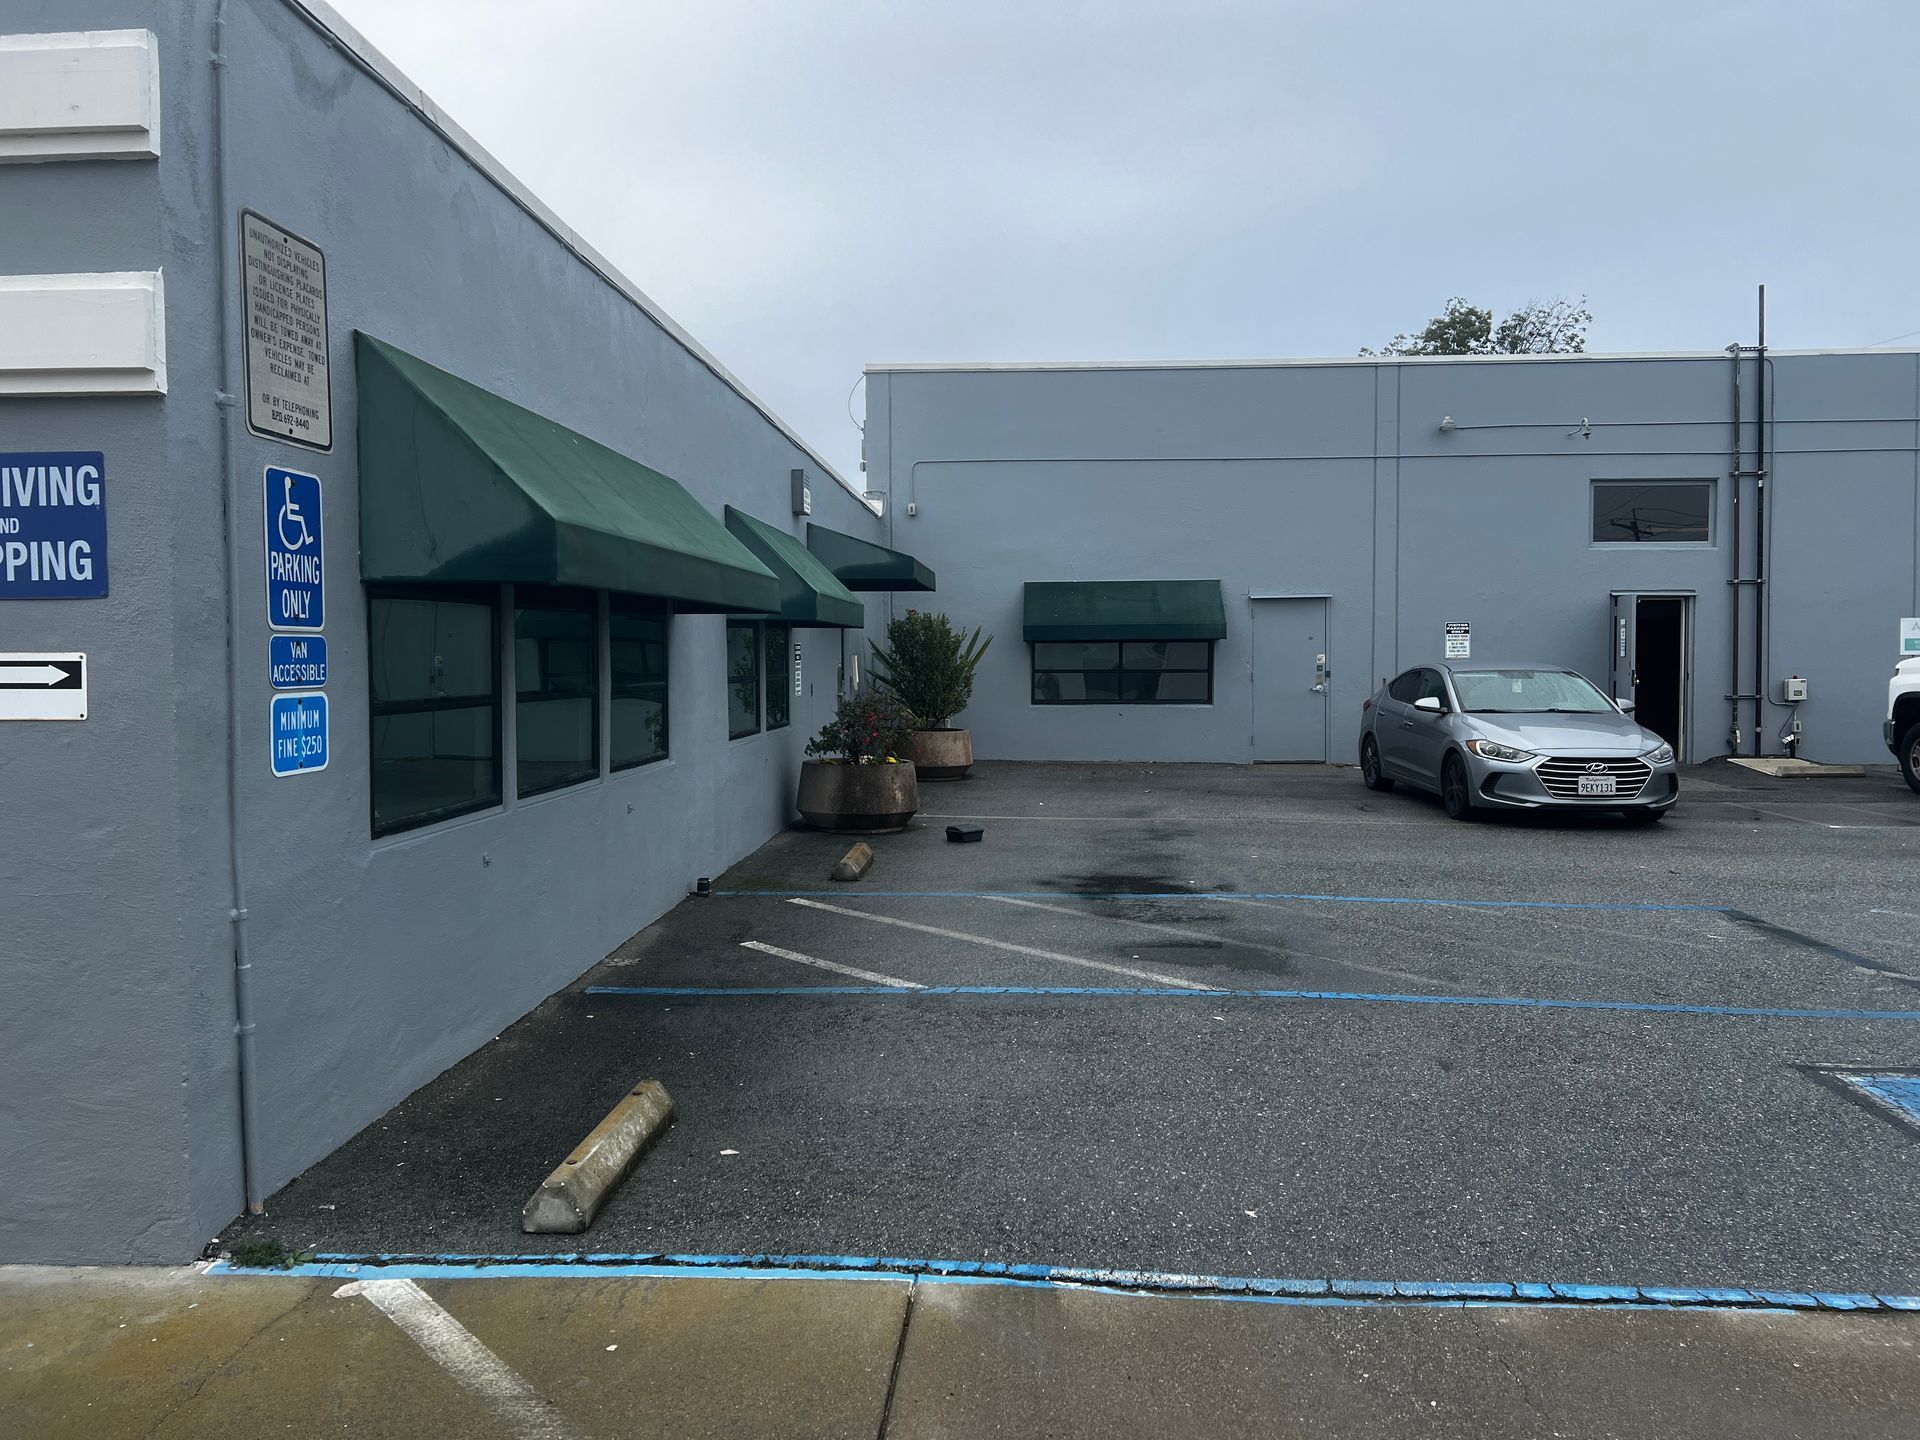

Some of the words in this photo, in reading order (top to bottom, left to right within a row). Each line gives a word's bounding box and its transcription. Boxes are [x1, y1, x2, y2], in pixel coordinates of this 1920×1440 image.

[249, 227, 291, 257] UNAUTHORIZED
[294, 251, 320, 272] VEHICLES
[264, 249, 274, 262] NOT
[277, 255, 308, 280] DISPLAYING
[248, 255, 293, 286] DISTINGUISHING
[296, 279, 322, 300] PLACARDS
[259, 274, 267, 287] OR
[270, 280, 293, 299] LICENSE
[296, 292, 315, 309] PLATES
[253, 286, 274, 304] ISSUED
[277, 296, 288, 310] FOR
[291, 303, 320, 324] PHYSICALLY
[255, 300, 293, 325] HANDICAPPED
[296, 319, 320, 338] PERSONS
[251, 327, 277, 346] OWNER'S
[308, 350, 325, 366] TOWED
[254, 315, 268, 329] WILL
[270, 321, 278, 333] BE
[281, 325, 298, 341] TOWED
[301, 334, 314, 347] AWAY
[265, 346, 292, 366] VEHICLES
[294, 358, 305, 371] MAY
[307, 363, 315, 374] BE
[270, 363, 301, 383] RECLAIMED
[304, 376, 310, 386] AT
[262, 392, 270, 404] OR
[273, 396, 280, 407] BY
[281, 399, 319, 420] TELEPHONING
[2, 465, 100, 507] IVING
[0, 540, 93, 581] PING
[271, 551, 320, 585] PARKING
[282, 588, 311, 619] ONLY
[290, 641, 308, 659] VAN
[273, 664, 325, 682] ACCESSIBLE
[280, 709, 320, 731] MINIMUM
[278, 738, 298, 758] FINE
[301, 735, 322, 758] $250
[1580, 783, 1614, 793] 9EKY131
